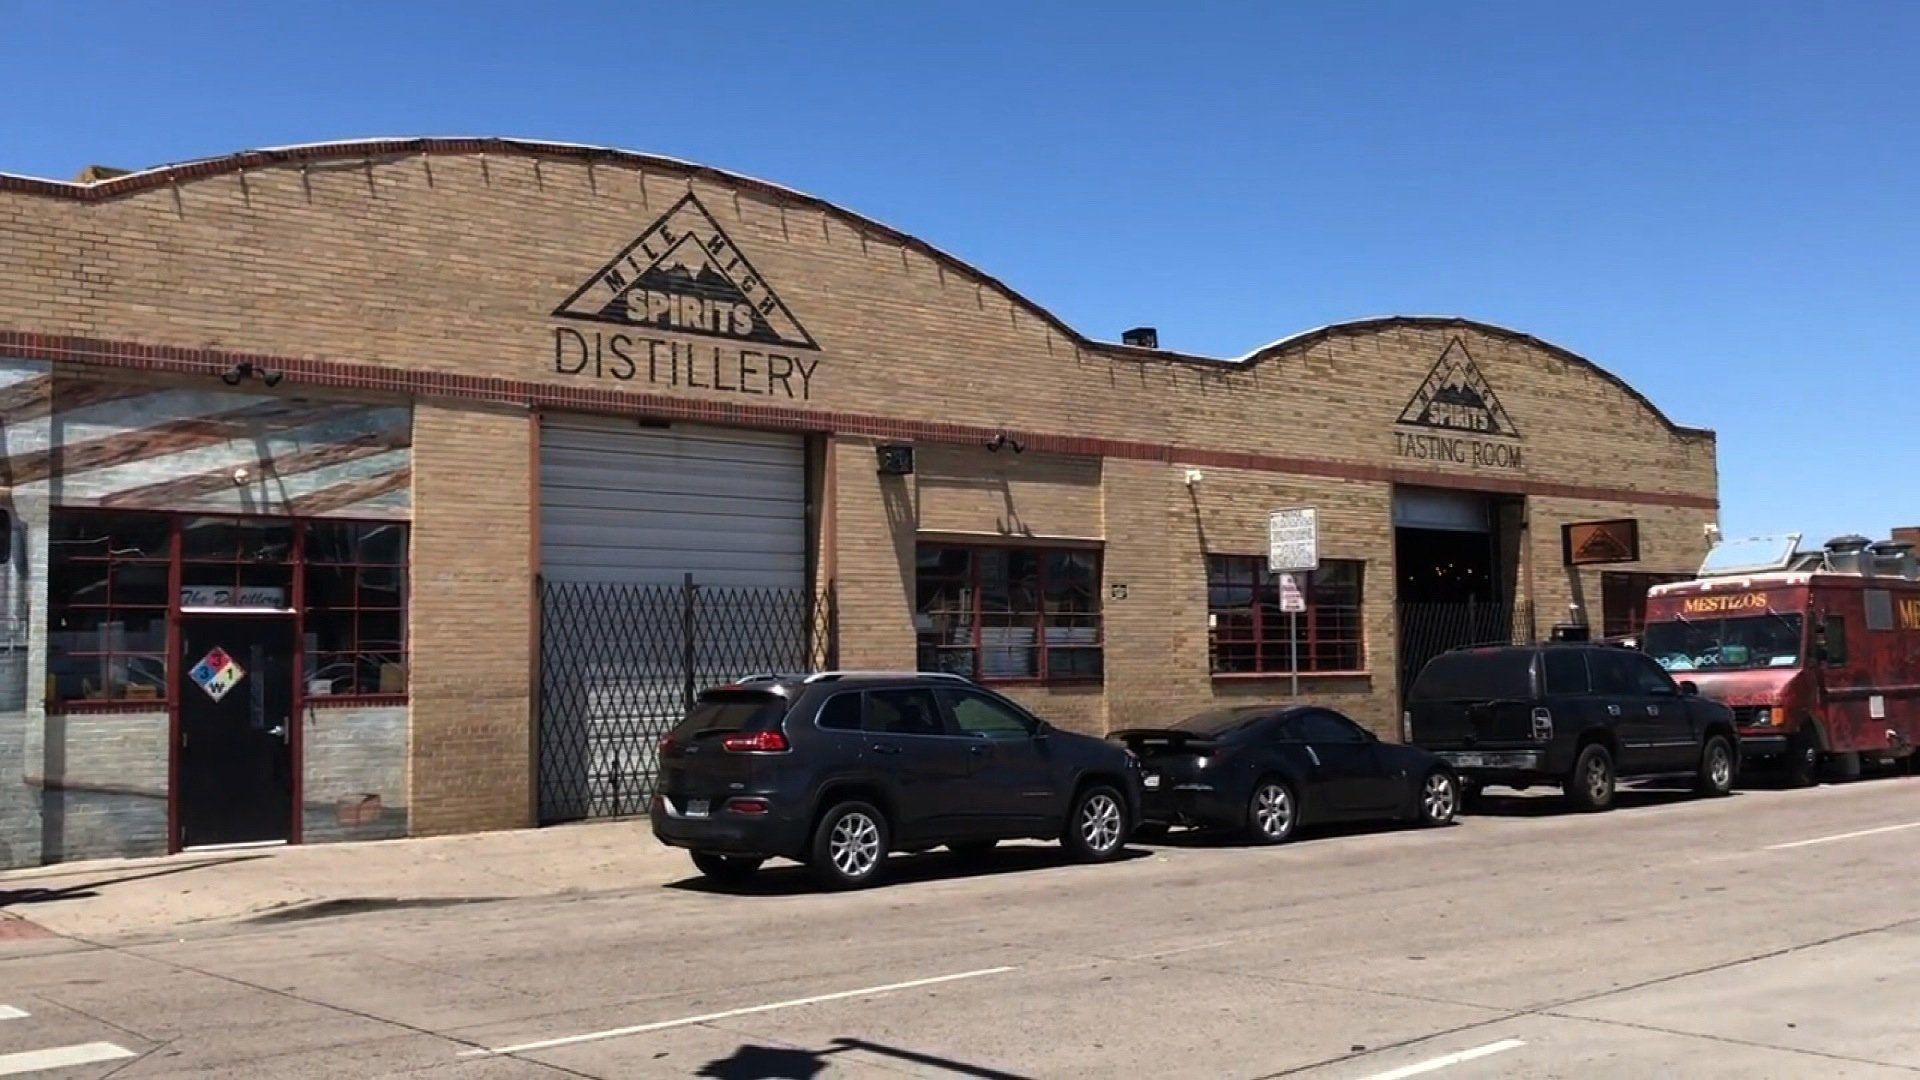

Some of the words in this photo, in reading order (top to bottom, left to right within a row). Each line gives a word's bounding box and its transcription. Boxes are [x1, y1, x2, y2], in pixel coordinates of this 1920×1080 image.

[603, 225, 676, 293] MILE
[708, 234, 775, 315] HIGH
[626, 290, 753, 335] SPIRITS
[555, 326, 819, 400] DISTILLERY
[1428, 401, 1489, 430] SPIRITS
[1393, 432, 1465, 463] TASTING
[1472, 441, 1522, 468] ROOM
[1684, 592, 1768, 614] MESTIZOS
[200, 666, 211, 680] 3
[208, 681, 226, 694] W
[226, 668, 234, 681] 1
